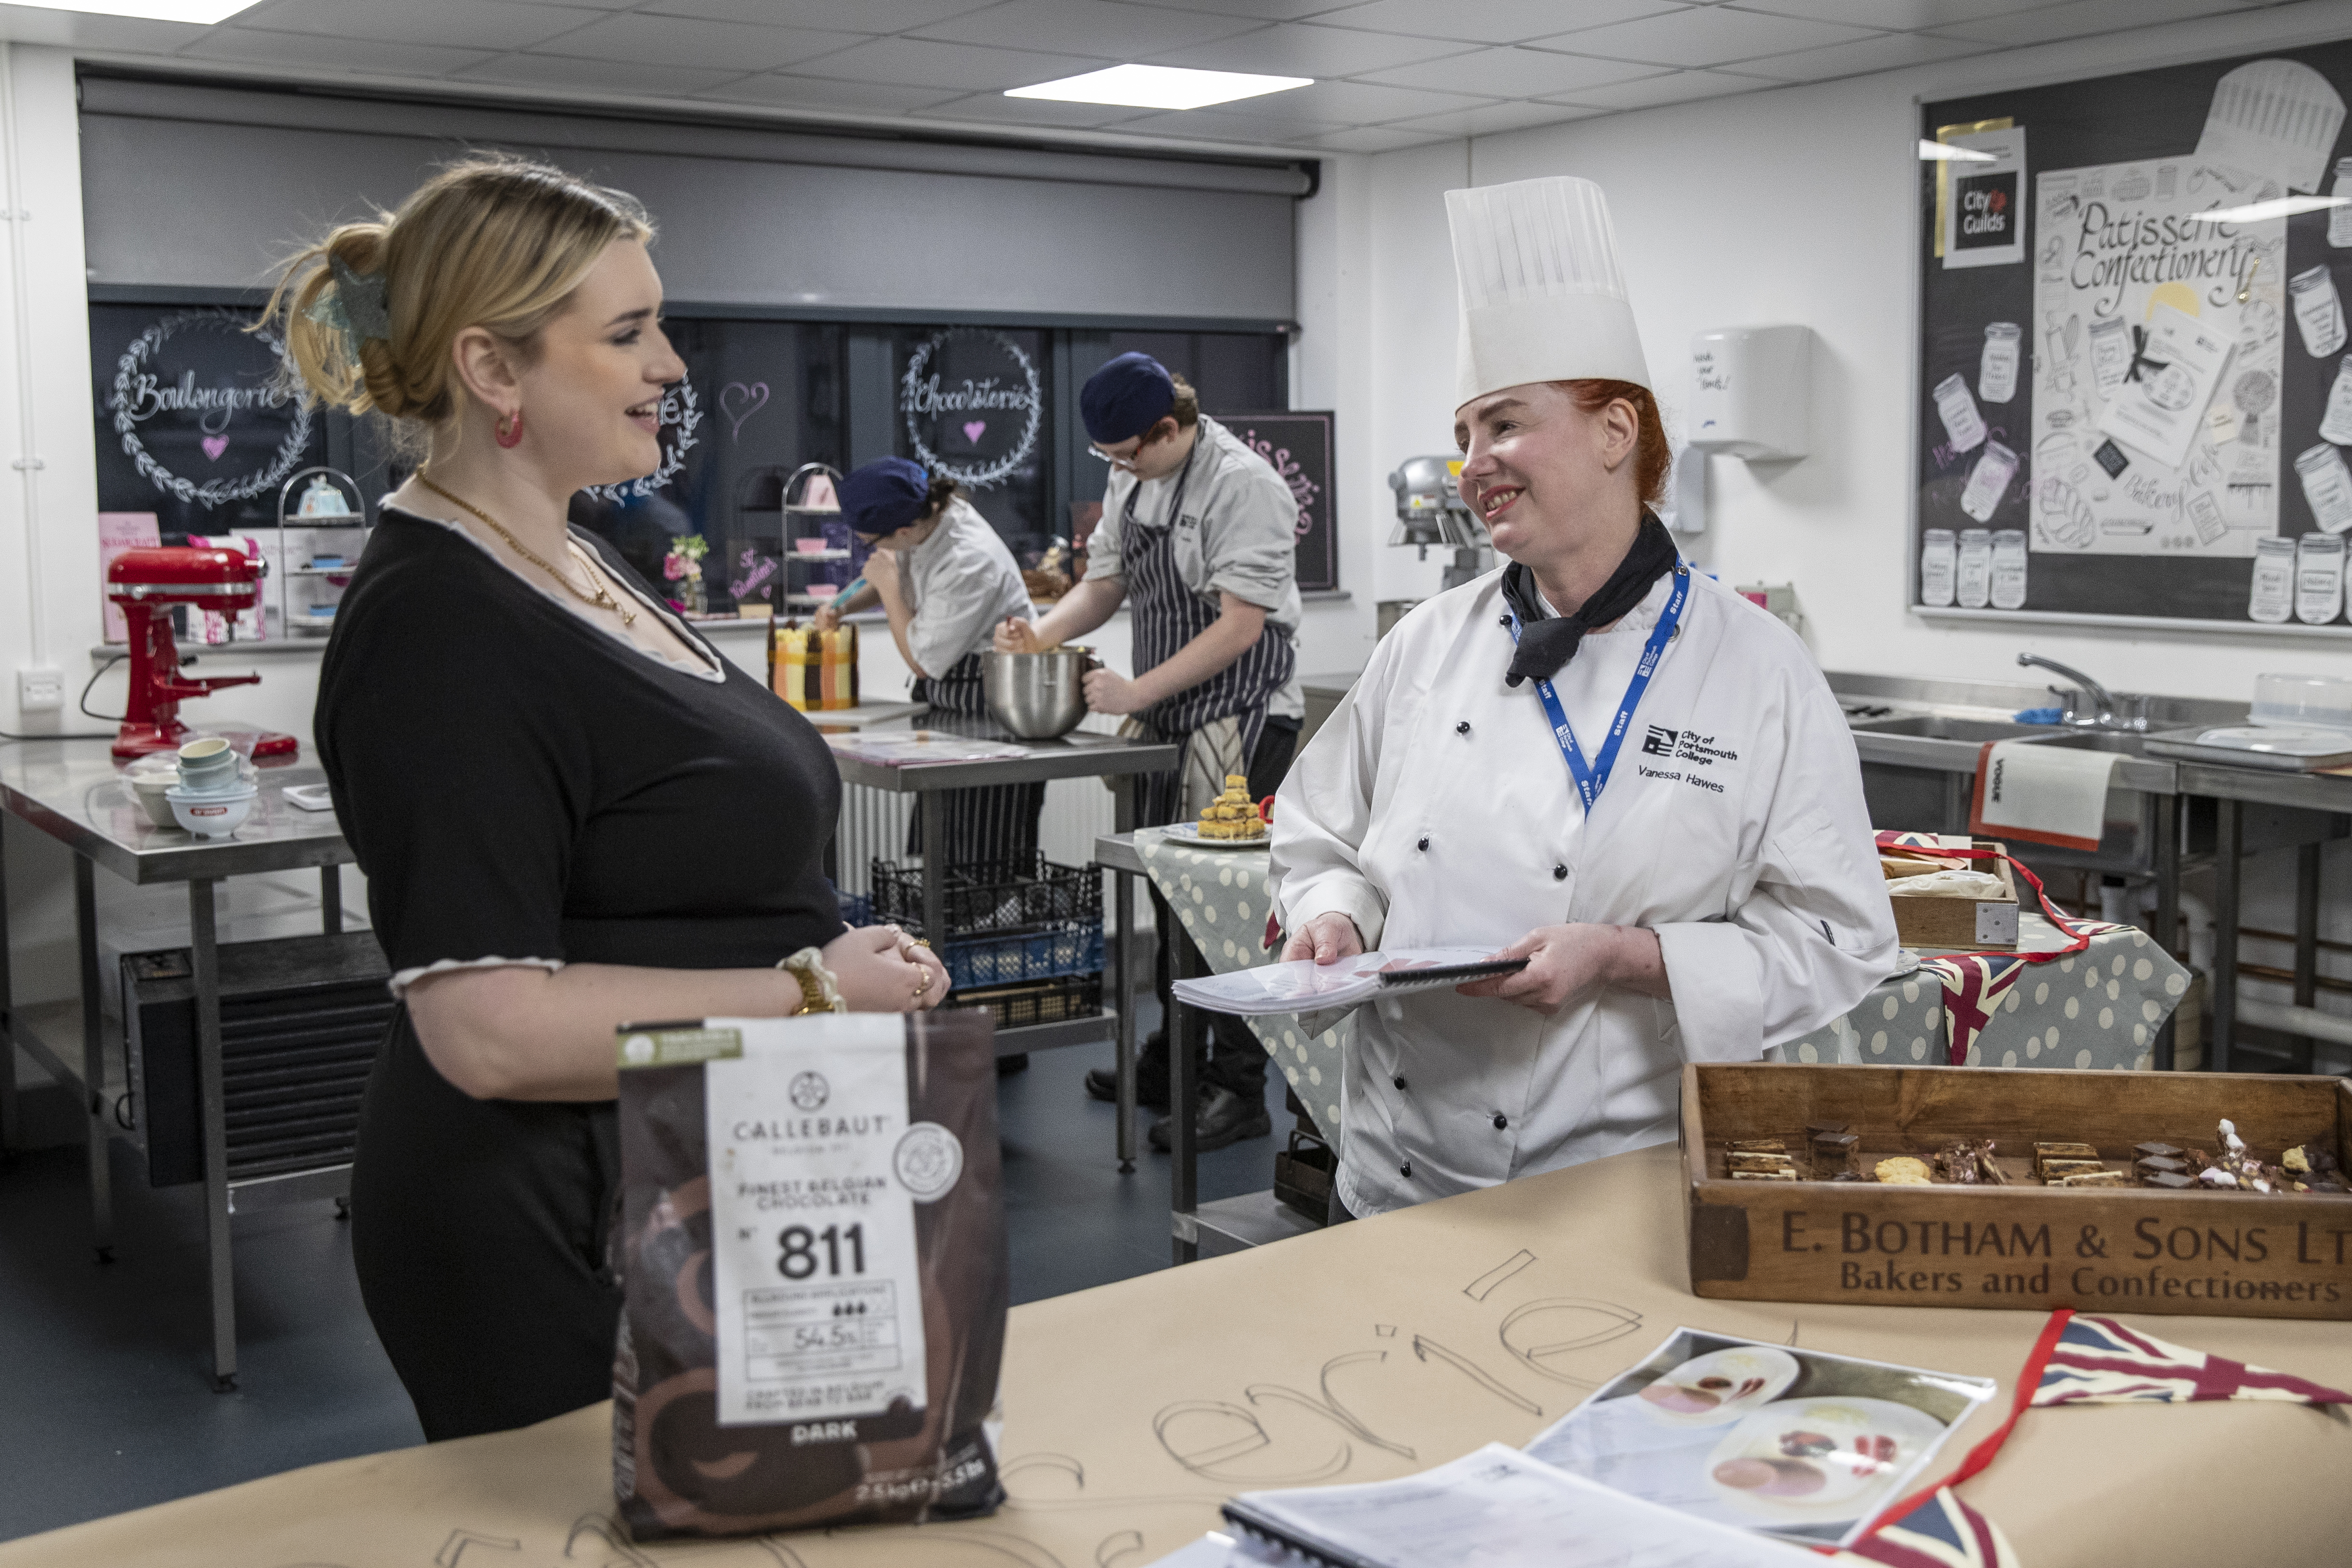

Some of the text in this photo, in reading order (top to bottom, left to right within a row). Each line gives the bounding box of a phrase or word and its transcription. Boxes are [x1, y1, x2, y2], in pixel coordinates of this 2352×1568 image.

[1964, 189, 1992, 215] City
[1964, 211, 2007, 235] Guilds
[2070, 244, 2257, 317] Confectionery
[128, 369, 293, 435] Boulangerie
[2124, 472, 2189, 524] Bakery
[1670, 590, 1683, 614] Staff
[1539, 679, 1552, 699] Staff
[1614, 710, 1628, 736] Staff
[1678, 740, 1738, 761] Portsmouth
[1681, 730, 1715, 745] City of
[1676, 750, 1713, 765] College
[1638, 764, 1725, 793] Vanessa Hawes
[1991, 758, 2005, 803] VOGUE
[734, 1115, 885, 1142] CALLEBAUT
[737, 1175, 887, 1198] FINEST BELGIAN
[756, 1192, 870, 1211] CHOCOLATE
[1782, 1211, 1824, 1253] E.
[1840, 1211, 2052, 1257] BOTHAM
[2075, 1224, 2108, 1259] &
[2133, 1216, 2268, 1263] SONS
[777, 1221, 866, 1280] 811
[1840, 1258, 2341, 1303] Bakers and Confectioners
[791, 1422, 858, 1445] DARK
